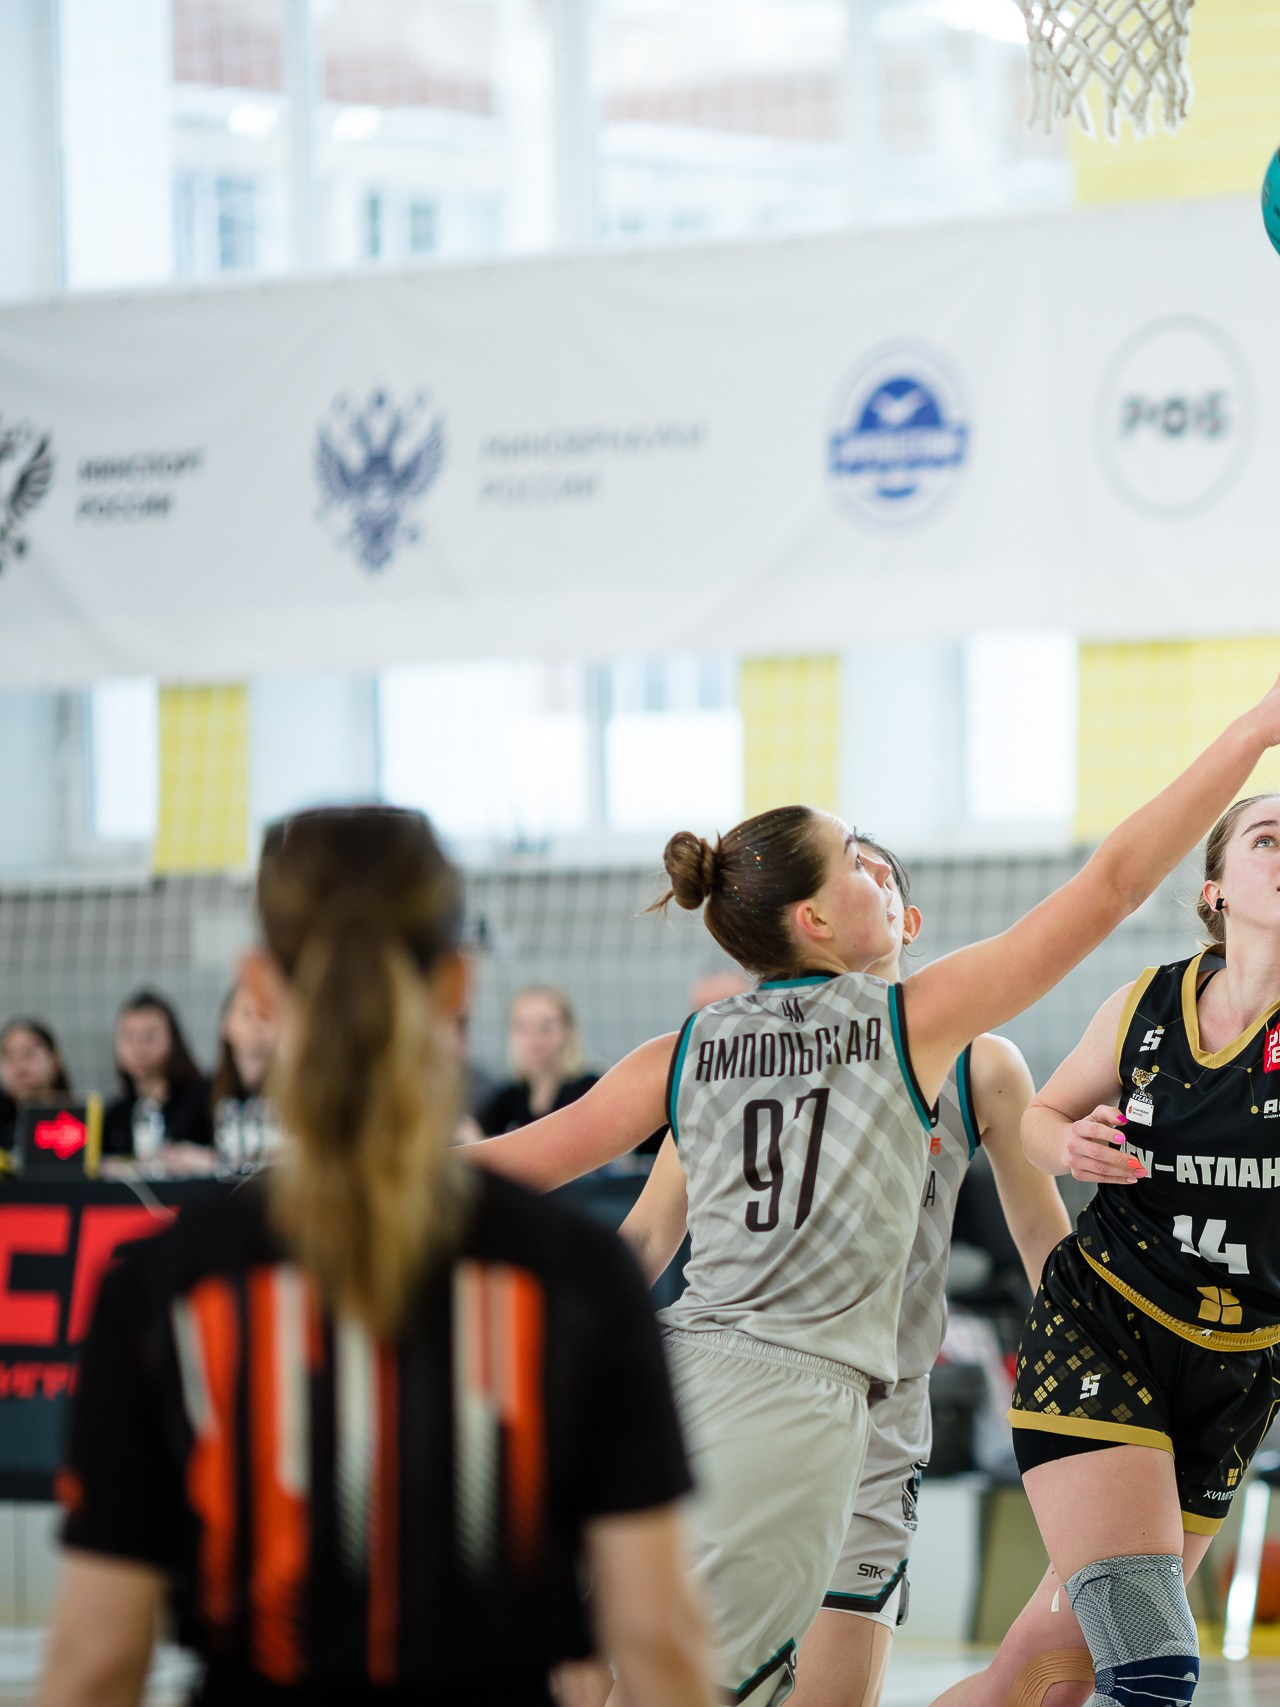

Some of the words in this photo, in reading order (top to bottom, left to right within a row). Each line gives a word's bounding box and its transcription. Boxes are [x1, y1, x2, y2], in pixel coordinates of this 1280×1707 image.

[695, 1017, 881, 1082] ЯМПОЛЬСКАЯ
[1173, 1214, 1250, 1275] 14
[857, 1563, 886, 1580] STK
